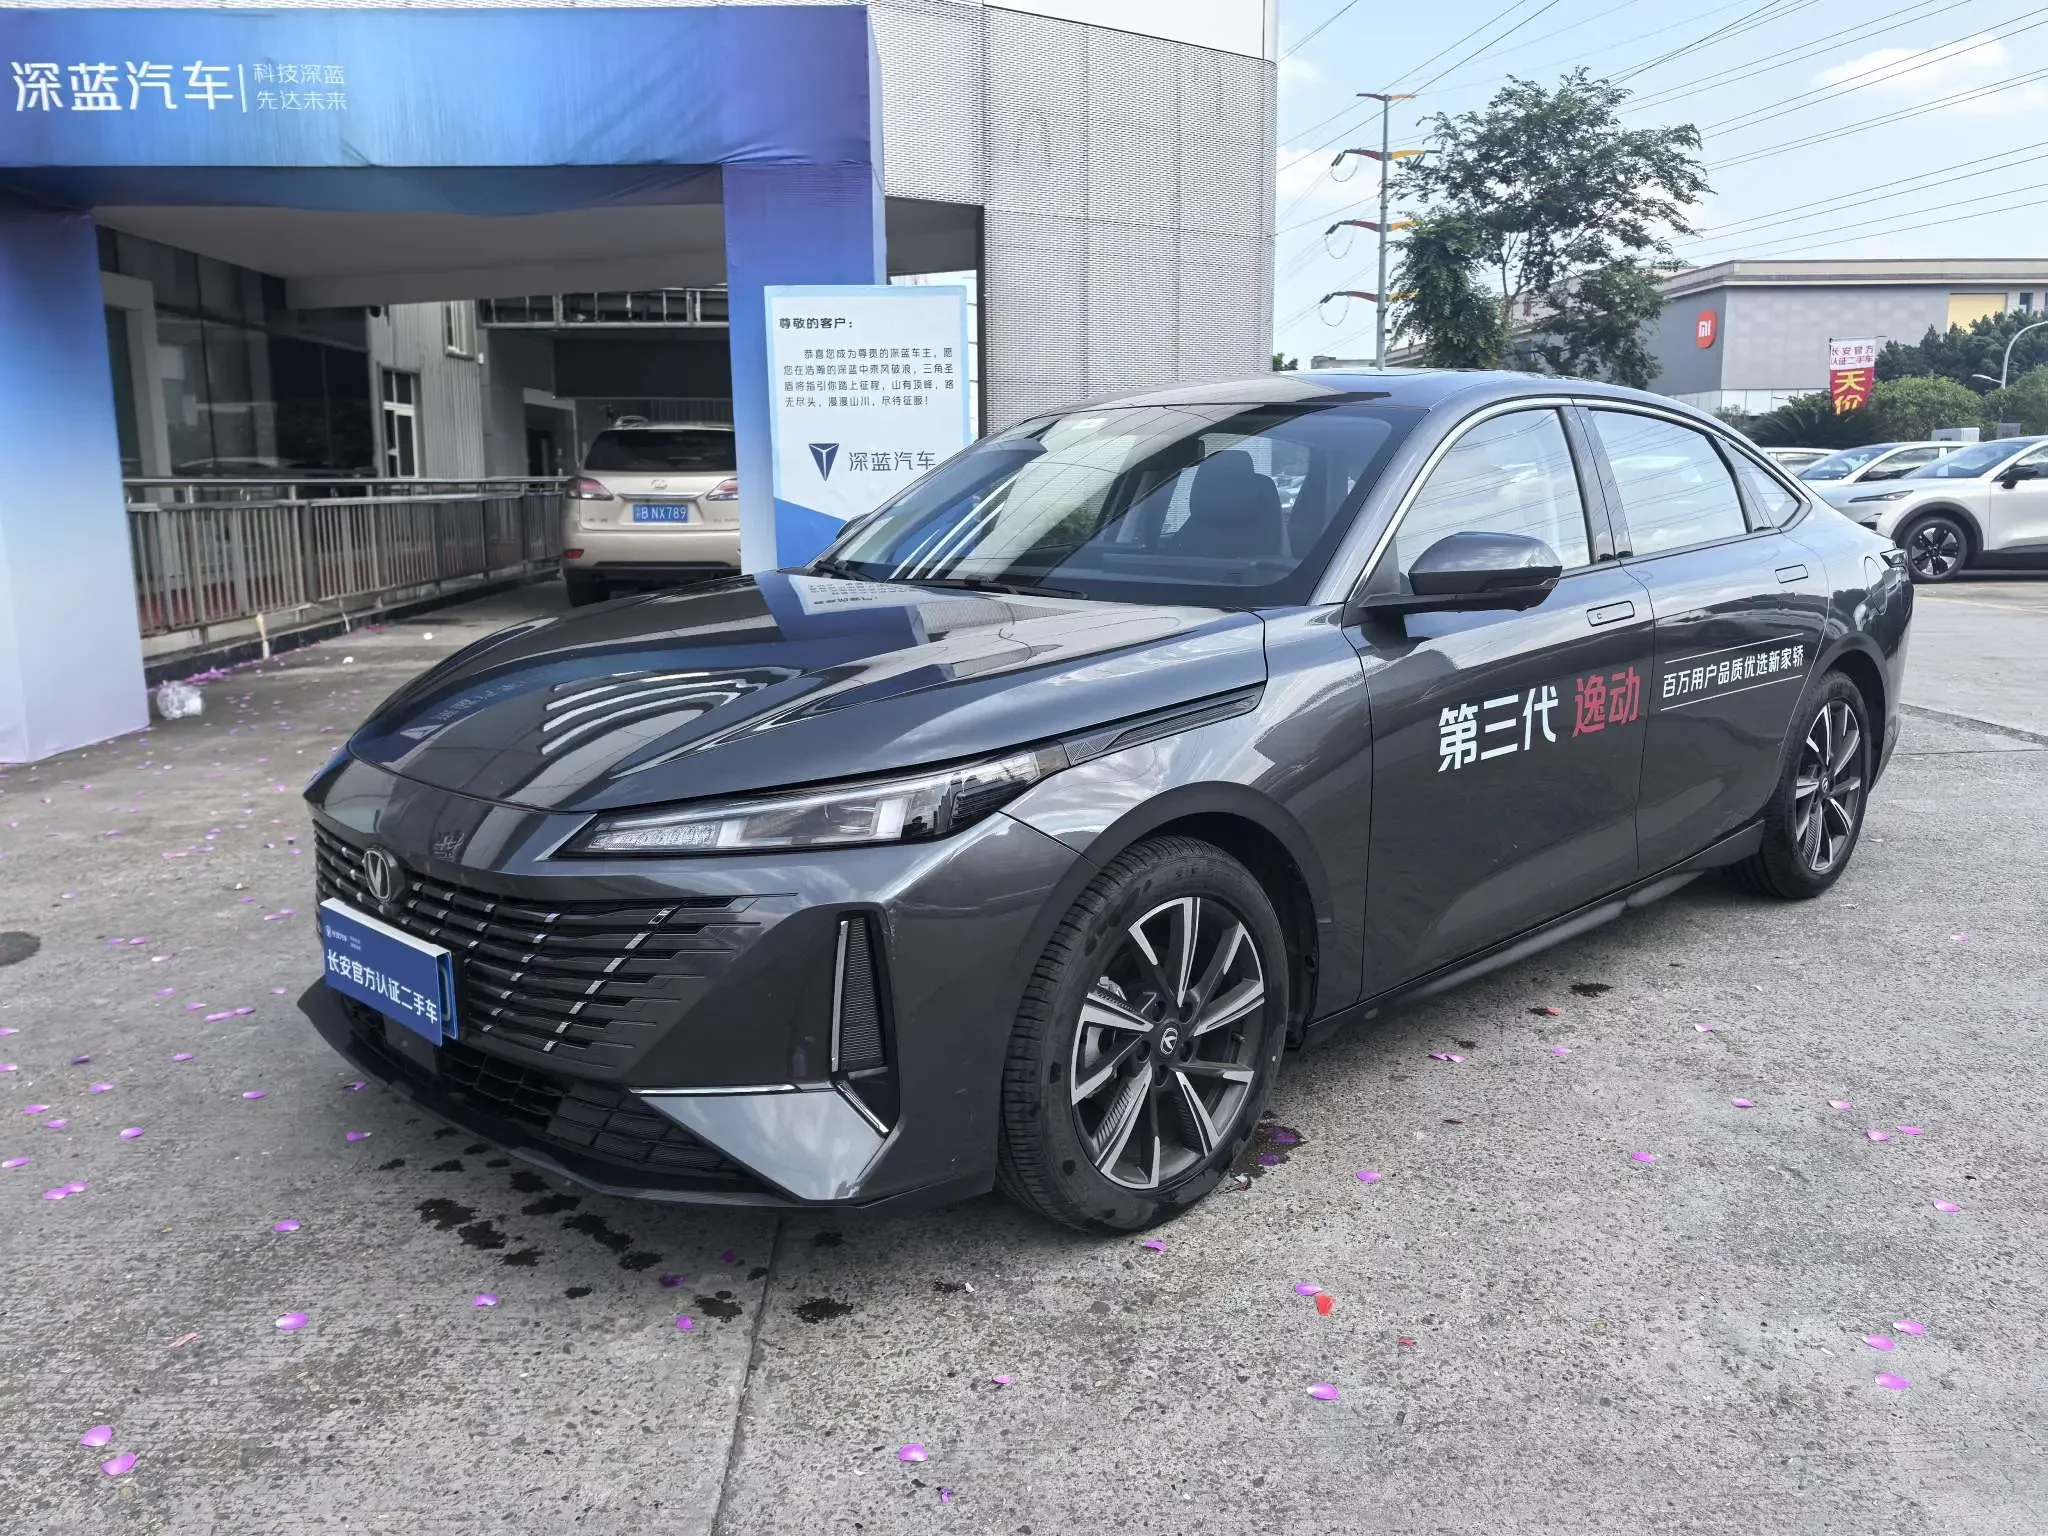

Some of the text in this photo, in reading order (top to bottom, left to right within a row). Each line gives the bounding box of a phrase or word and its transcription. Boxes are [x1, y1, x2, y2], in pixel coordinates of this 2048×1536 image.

[11, 60, 234, 112] 深蓝汽车
[253, 63, 346, 85] 科技深蓝
[255, 89, 349, 112] 先达未来
[779, 317, 853, 330] 尊敬的客户：
[849, 450, 936, 472] 深蓝汽车
[1663, 645, 1804, 699] 百万用户品质优选新家轿
[1438, 666, 1641, 773] 第三代 逸动
[327, 949, 438, 1024] 长安官方认证二手车
